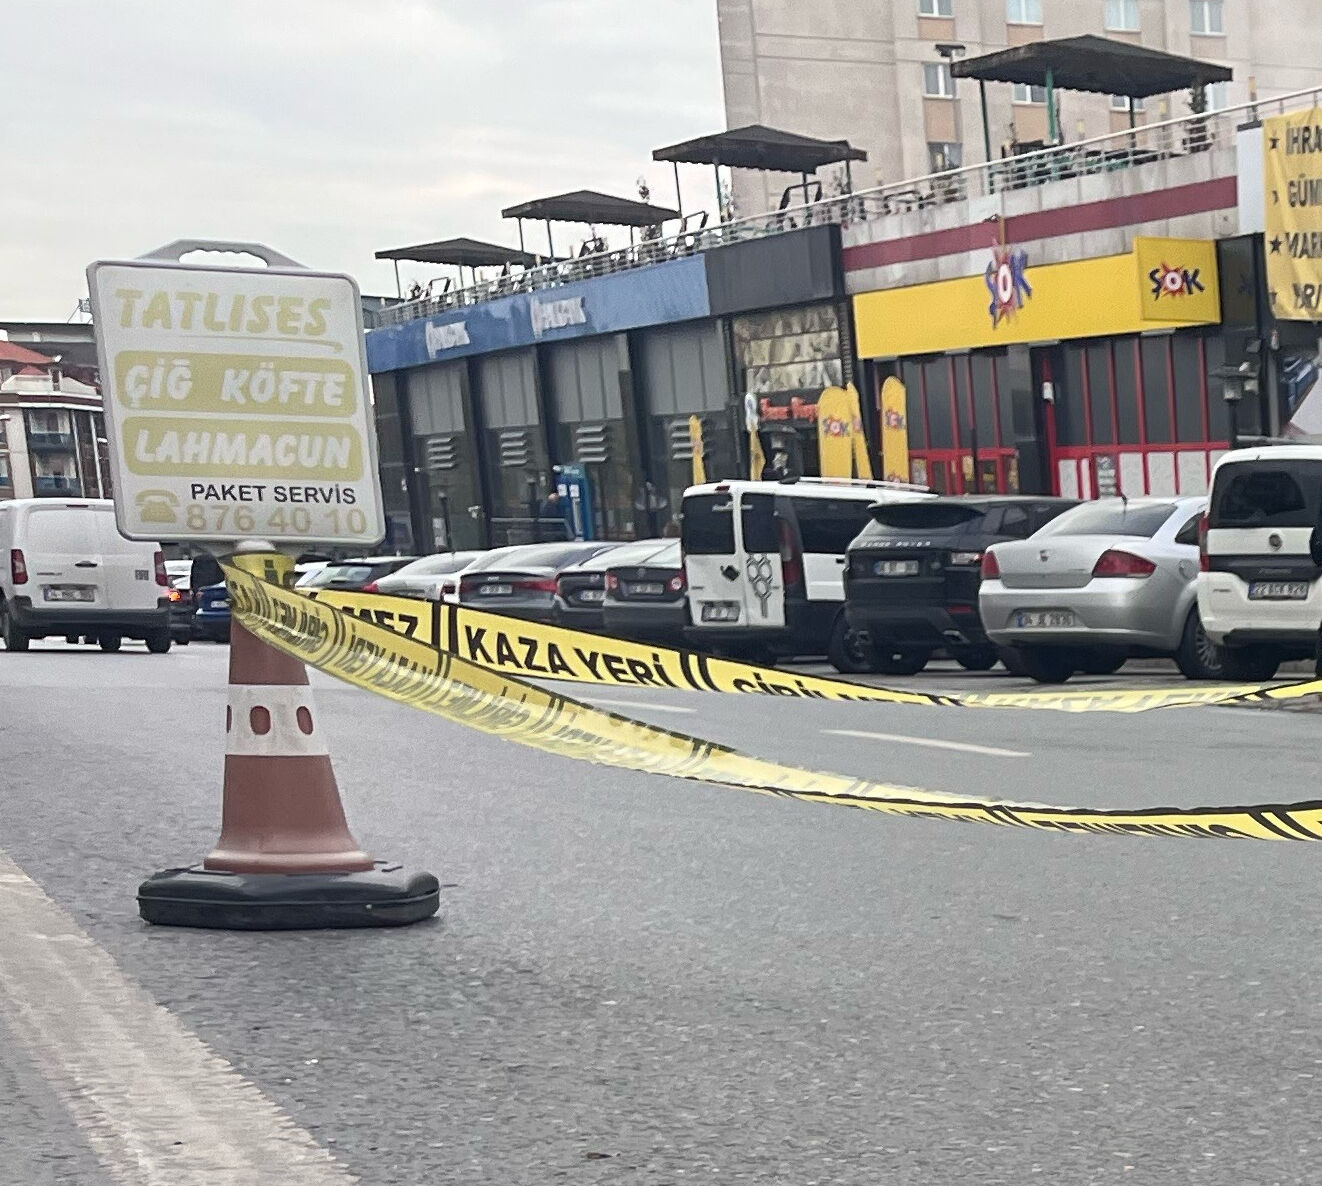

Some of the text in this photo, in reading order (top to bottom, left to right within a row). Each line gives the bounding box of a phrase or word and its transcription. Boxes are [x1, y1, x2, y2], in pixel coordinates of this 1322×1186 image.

[1148, 264, 1205, 302] ŞOK
[115, 288, 331, 336] TATLISES
[124, 358, 346, 408] ÇİĞ KÖFTE
[134, 428, 350, 469] LAHMACUN
[190, 483, 356, 505] PAKET SERVİS
[186, 504, 367, 535] 876 40 10
[465, 624, 672, 689] KAZA YERİ
